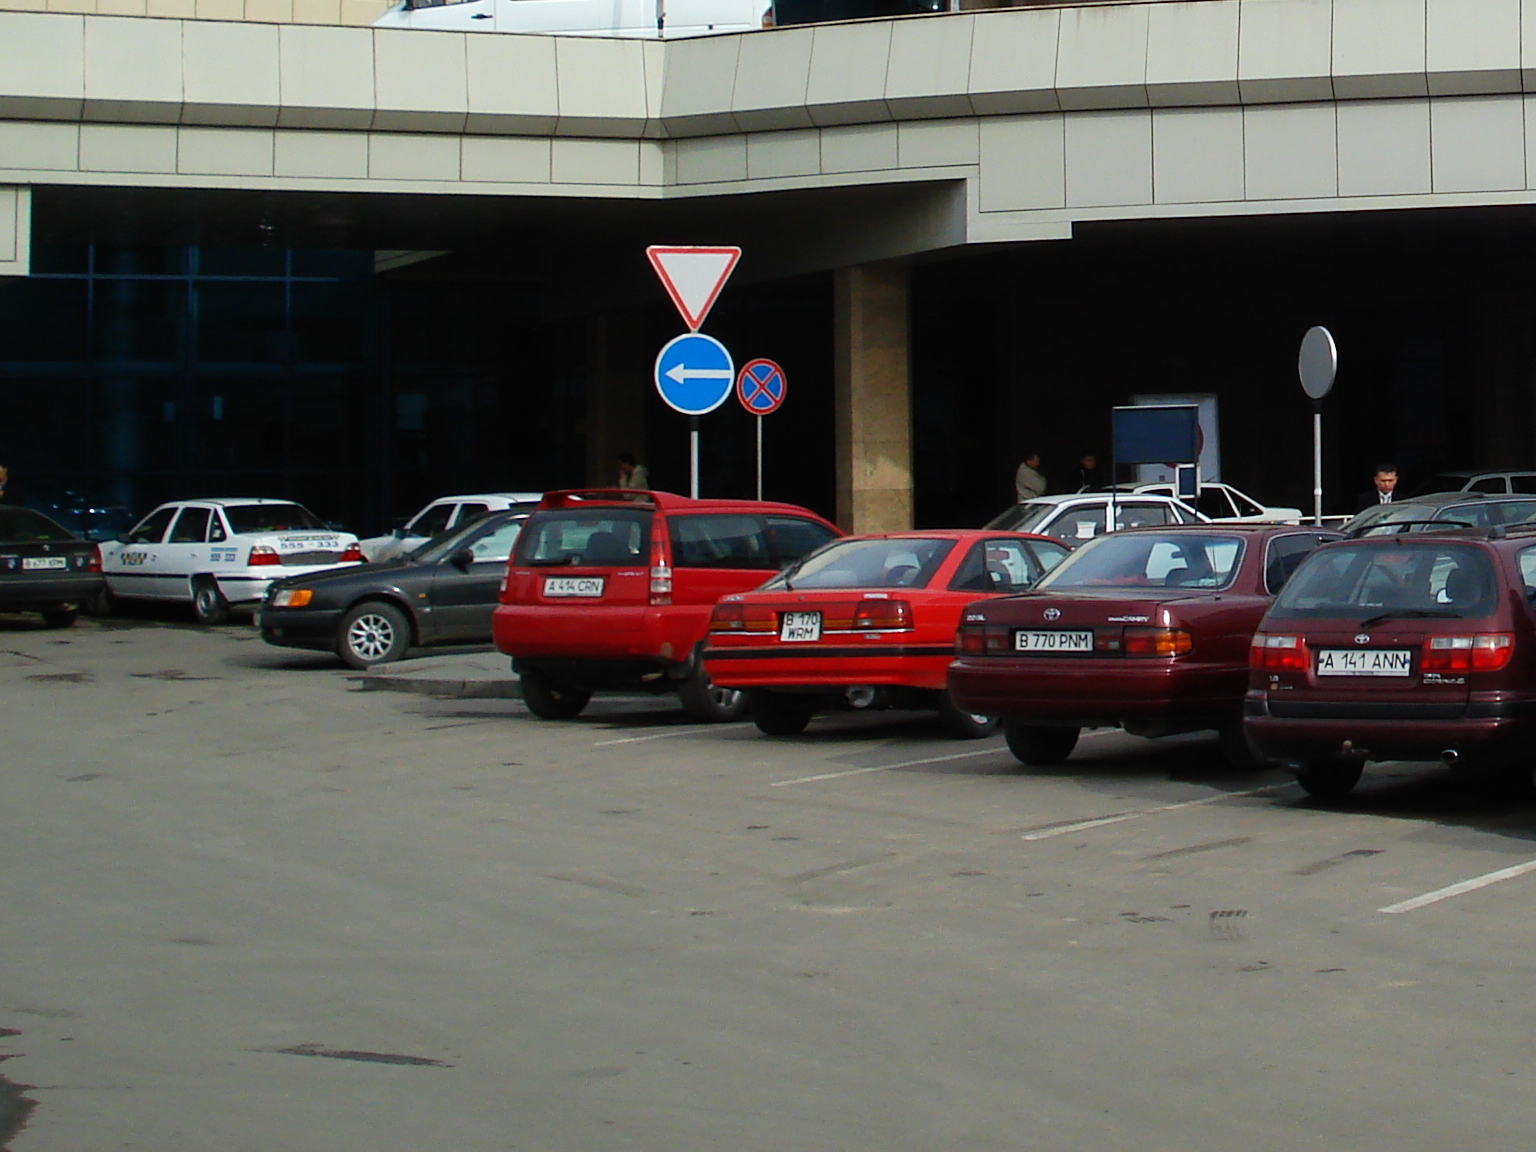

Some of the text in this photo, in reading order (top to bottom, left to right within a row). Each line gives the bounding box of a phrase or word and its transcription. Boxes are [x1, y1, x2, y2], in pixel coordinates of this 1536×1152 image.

[548, 580, 555, 591] A
[785, 611, 818, 626] B 170
[1019, 633, 1089, 648] B 770 PNM
[1324, 652, 1407, 669] A 141 ANN
